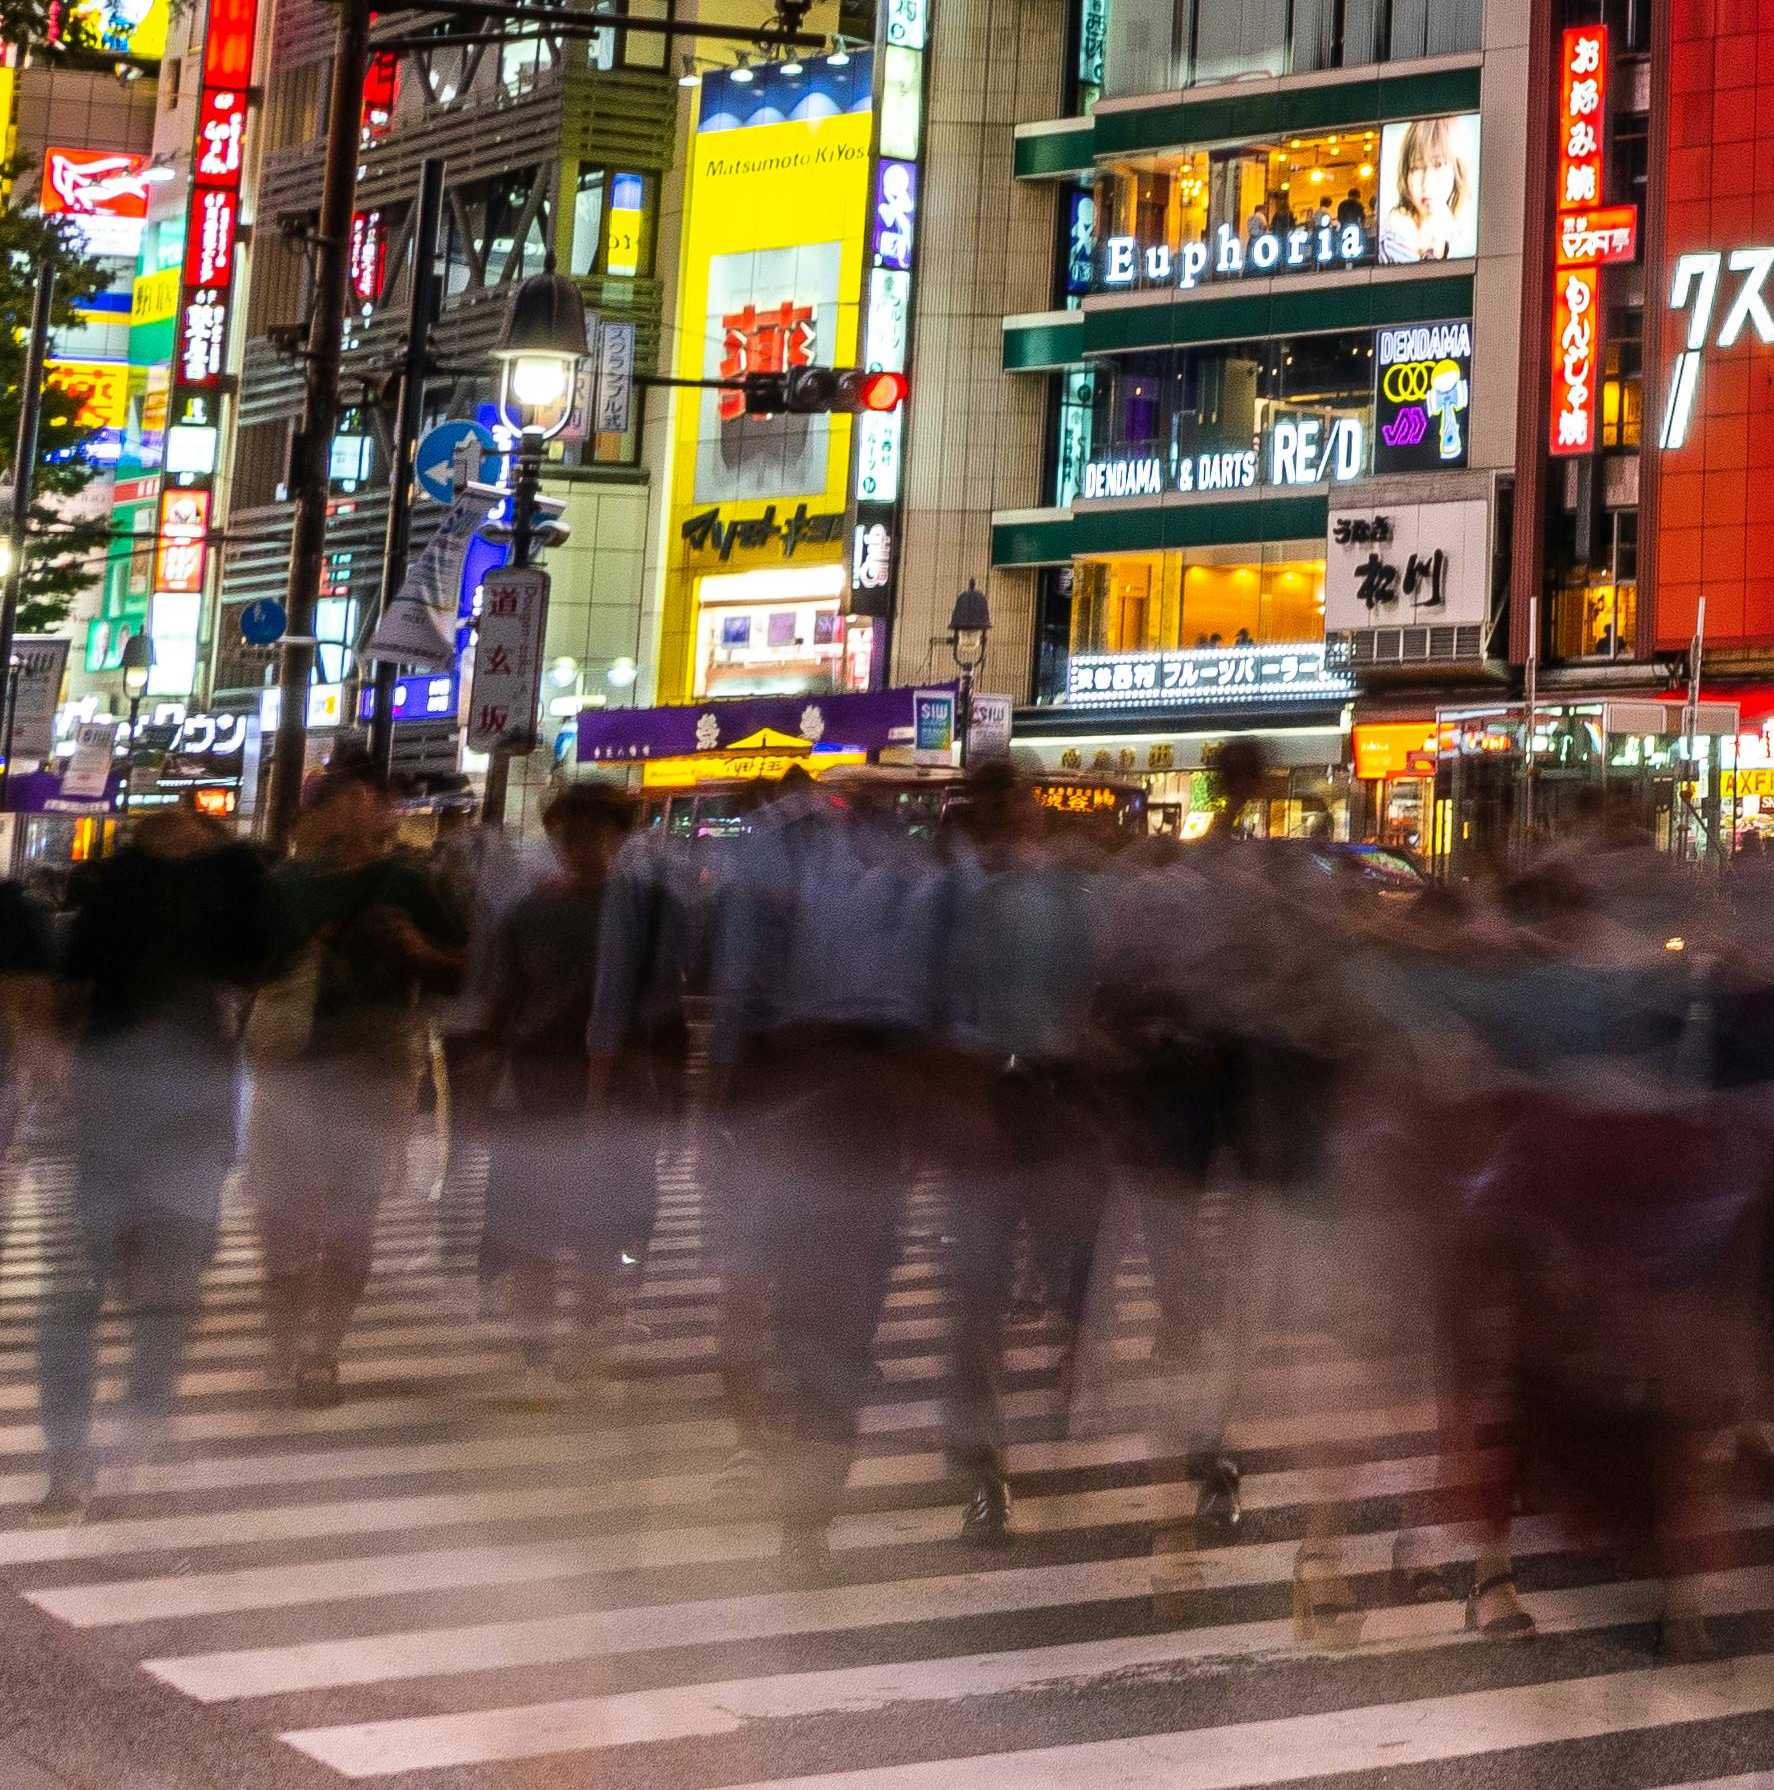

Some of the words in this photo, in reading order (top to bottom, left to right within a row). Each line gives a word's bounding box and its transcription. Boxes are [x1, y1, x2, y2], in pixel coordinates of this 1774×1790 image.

[1565, 37, 1599, 201] お好み焼
[706, 151, 811, 178] Matsumoto
[1105, 215, 1365, 288] Euphoria
[1379, 321, 1472, 366] DENDAMA
[1558, 275, 1590, 447] もんじゃ焼
[1084, 457, 1162, 500] DENDAMA
[1179, 458, 1195, 492] &
[1198, 450, 1256, 491] DARTS
[1332, 514, 1393, 546] うなぎ
[479, 586, 518, 735] 道玄坂
